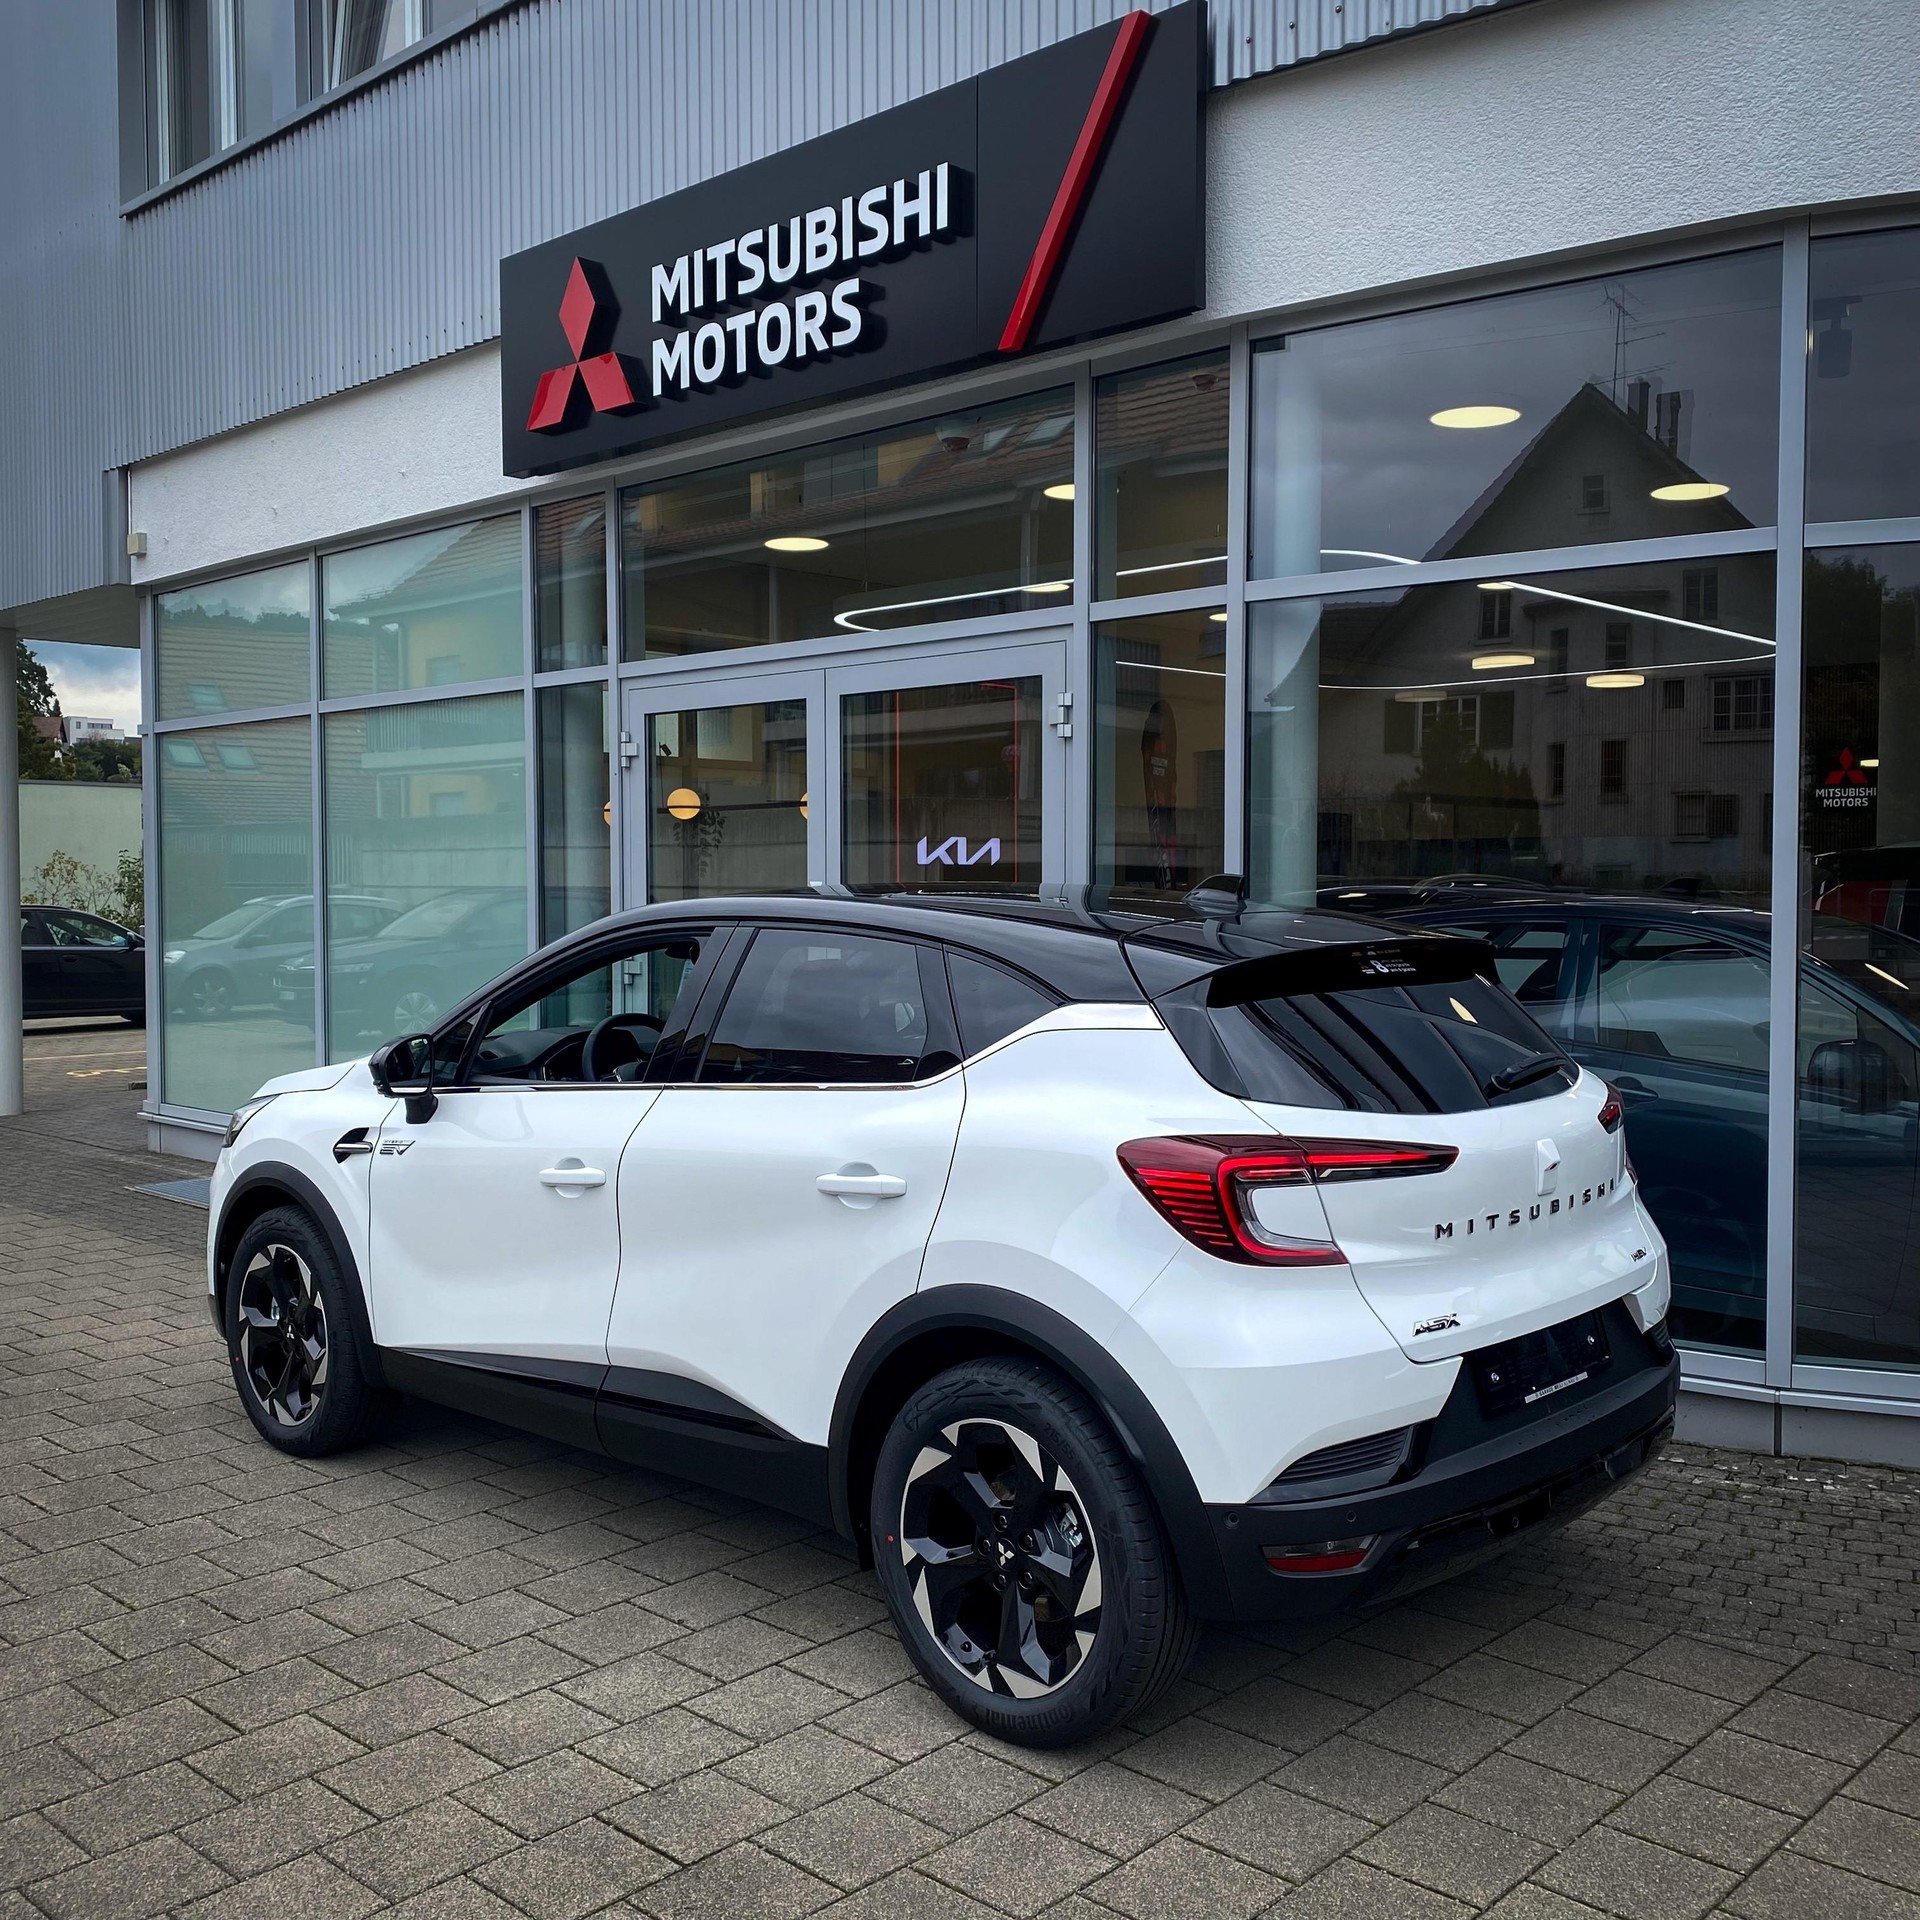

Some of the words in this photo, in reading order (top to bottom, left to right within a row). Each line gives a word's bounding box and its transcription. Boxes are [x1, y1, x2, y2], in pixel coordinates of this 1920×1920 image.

[651, 161, 949, 323] MITSUBISHI
[652, 277, 862, 397] MOTORS
[1815, 787, 1877, 798] MITSUBISHI
[1823, 797, 1869, 808] MOTORS
[917, 835, 1001, 866] KIA
[379, 1140, 416, 1156] EV
[1434, 1177, 1616, 1240] MITSUBISHI
[1412, 1313, 1461, 1337] ASX
